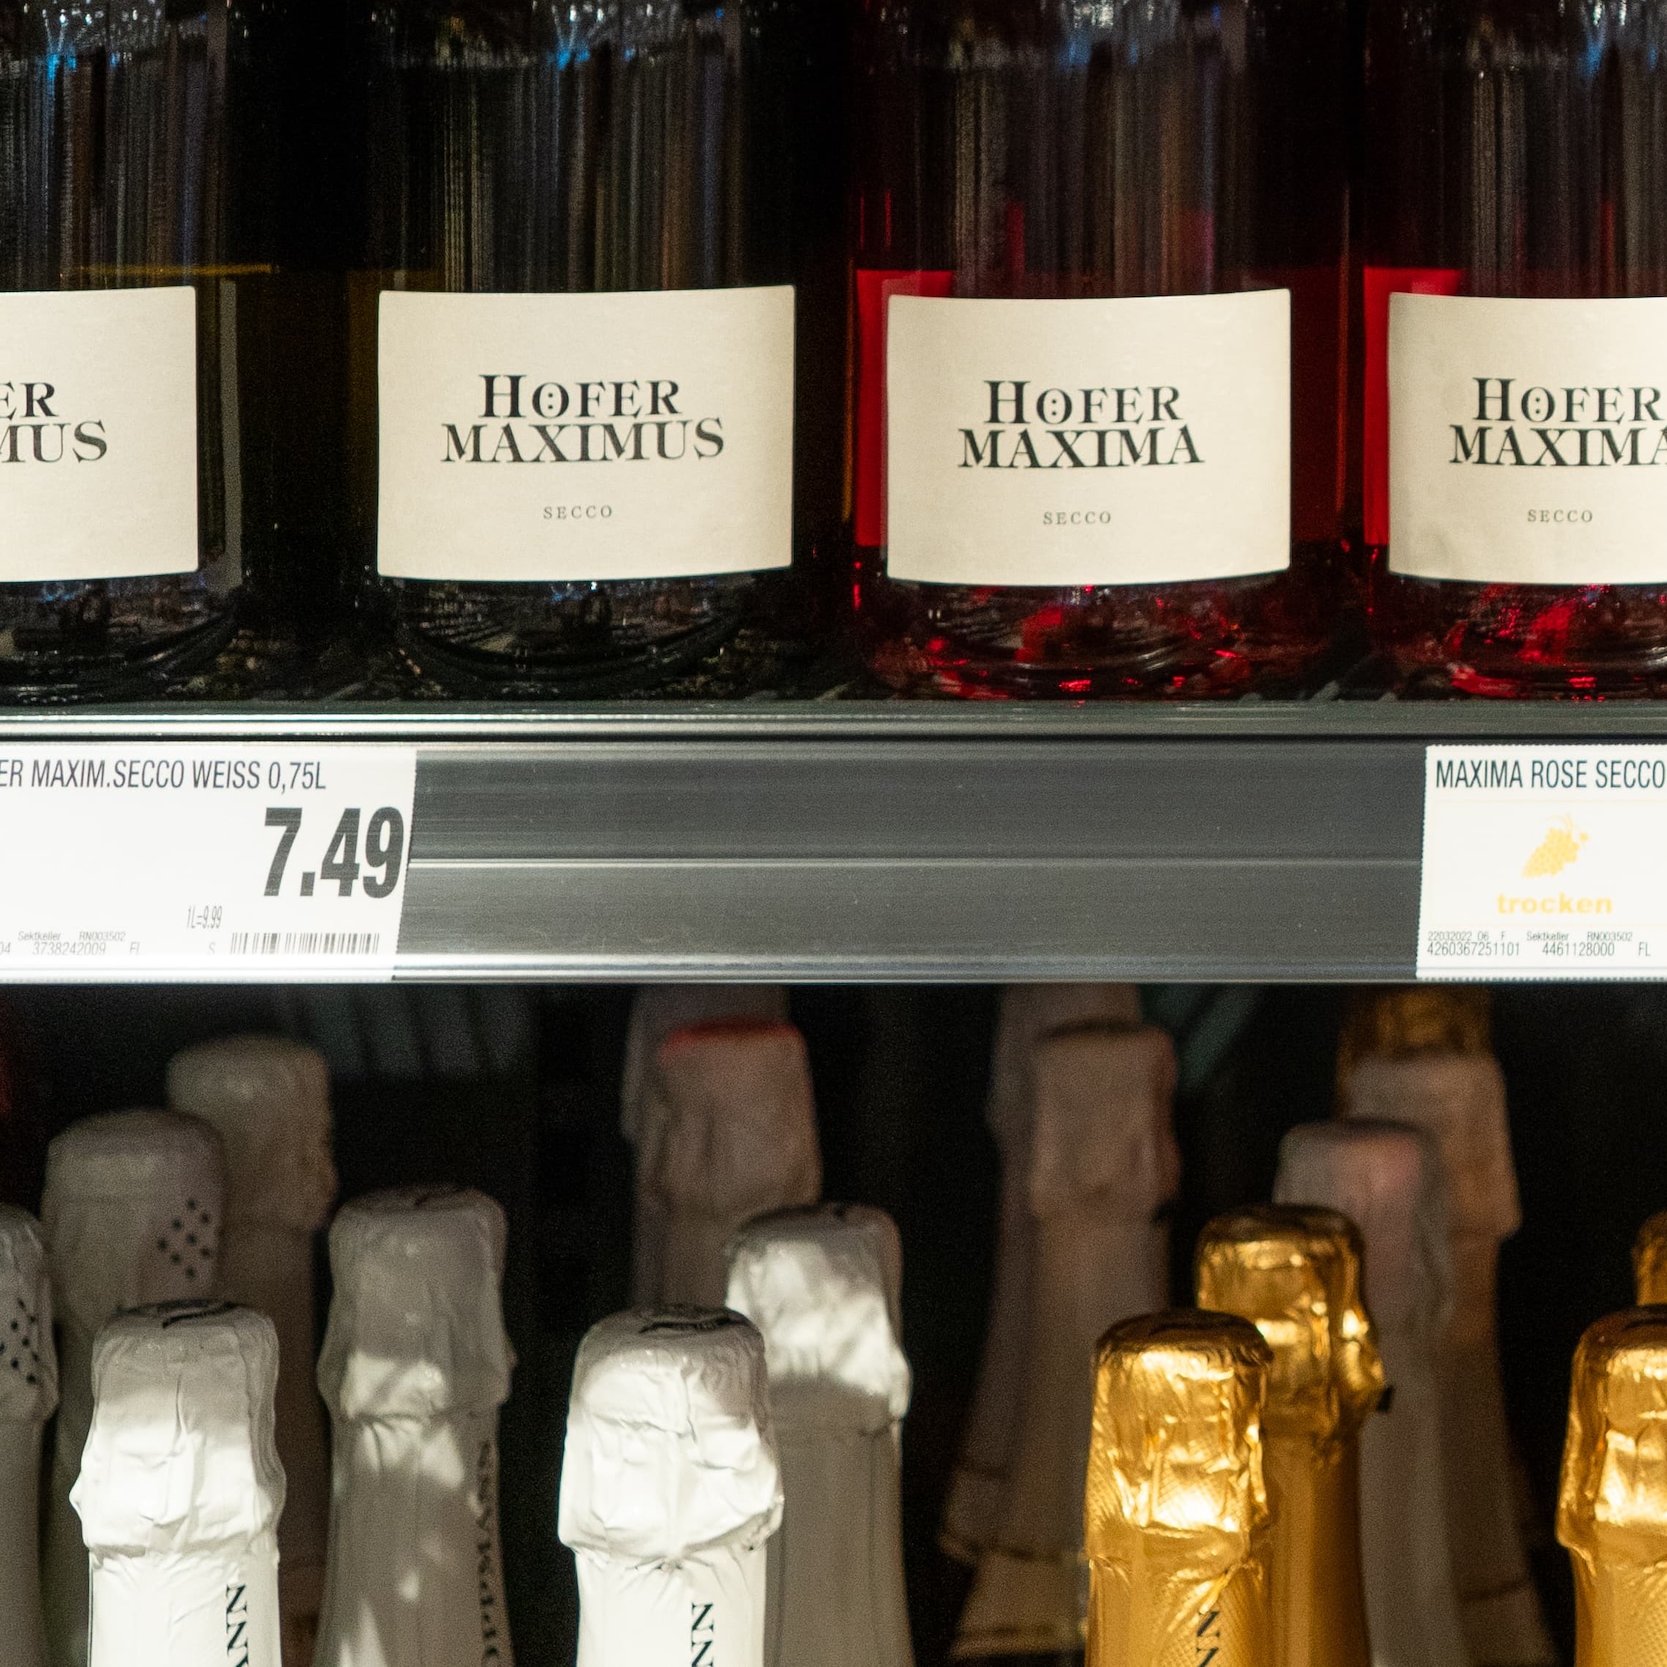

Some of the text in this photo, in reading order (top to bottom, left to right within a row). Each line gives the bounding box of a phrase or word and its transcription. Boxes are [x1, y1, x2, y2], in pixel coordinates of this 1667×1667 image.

[440, 416, 727, 464] MAXIMUS
[957, 423, 1206, 470] MAXIMA
[541, 504, 615, 520] SECCO
[1041, 509, 1113, 527] SECCO
[1525, 507, 1596, 525] SECCO
[31, 759, 185, 789] MAXIM.SECCO
[192, 761, 261, 789] WEISS
[268, 761, 327, 794] 0,75L
[1435, 759, 1524, 790] MAXIMA
[1530, 760, 1588, 789] ROSE
[1595, 760, 1666, 790] SECCO
[264, 806, 405, 899] 7.49
[1496, 892, 1613, 916] trocken
[1638, 941, 1651, 957] FL
